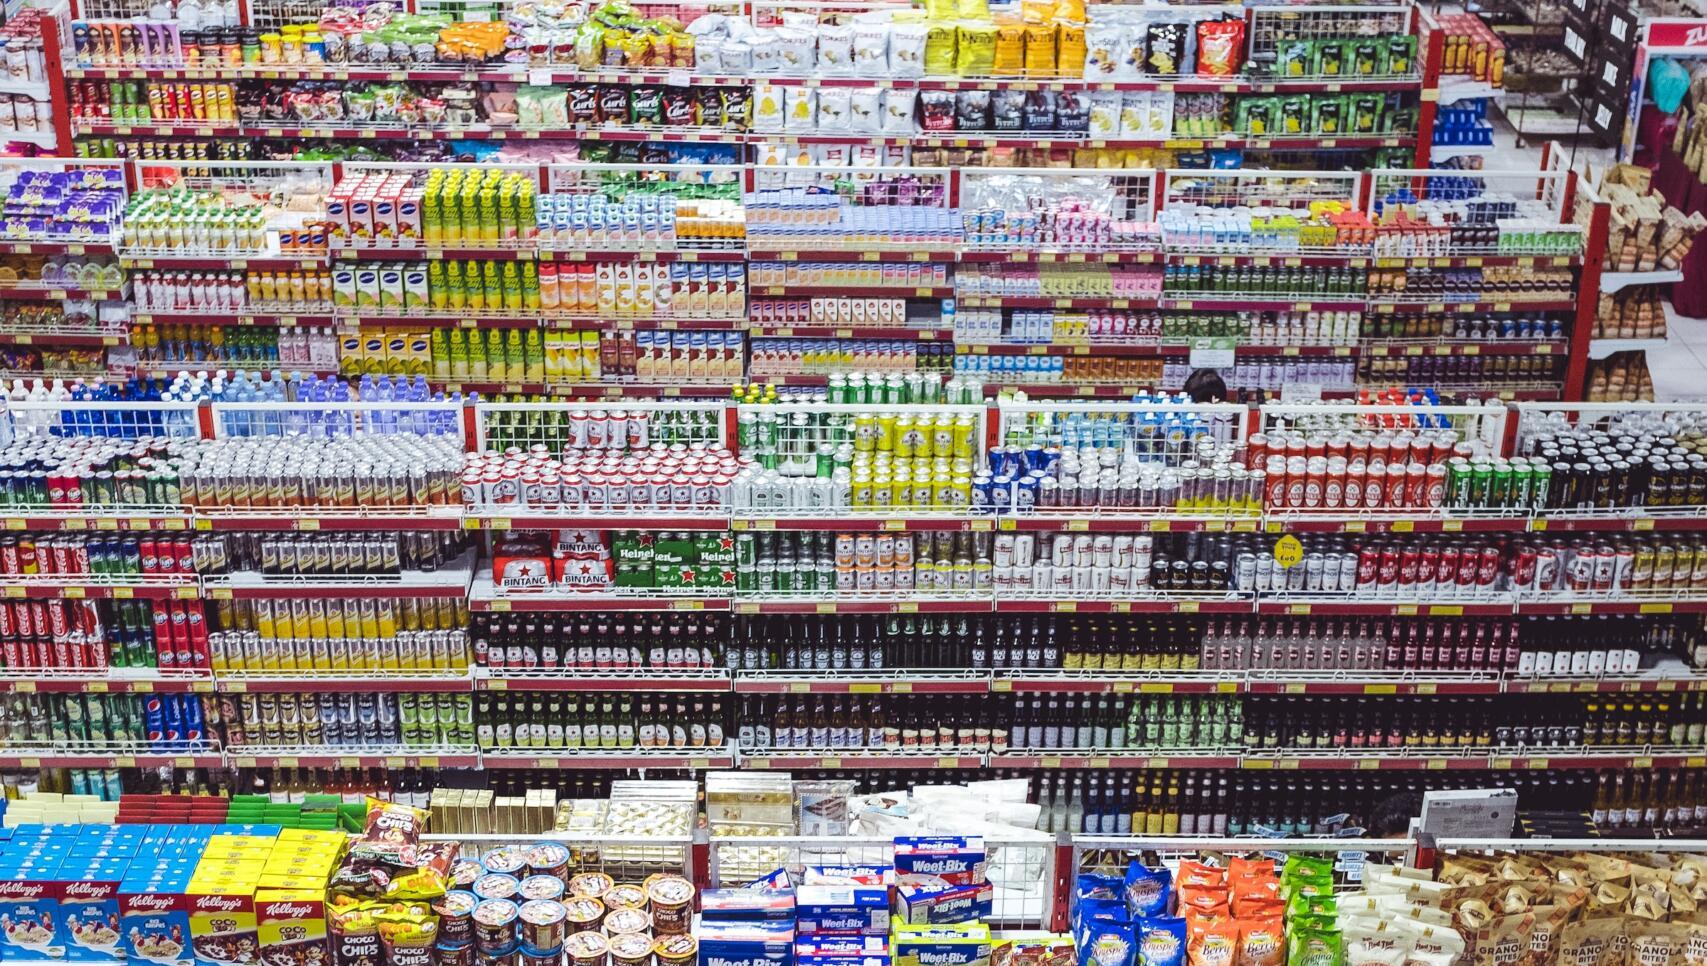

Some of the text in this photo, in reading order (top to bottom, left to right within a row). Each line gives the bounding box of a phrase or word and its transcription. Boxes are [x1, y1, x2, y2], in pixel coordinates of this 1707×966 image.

[504, 577, 546, 587] BINTANG
[565, 575, 607, 583] BINTANG
[382, 811, 413, 821] CHOCO
[377, 816, 414, 832] CHIPS
[823, 867, 877, 876] Weet-Bix
[912, 860, 968, 872] Weet-Bix
[0, 882, 43, 896] Kellogg's
[66, 882, 111, 897] Kellogg's
[129, 895, 175, 909] Kellogg's
[196, 896, 242, 910] Kellogg's
[266, 902, 313, 918] Kellogg's
[821, 919, 864, 928] Weet-Bix
[342, 944, 378, 956] CHIPS
[1203, 944, 1230, 957] Berry
[1248, 942, 1276, 953] Berry
[393, 953, 430, 966] CHIPS
[920, 953, 967, 963] Weet-Bix
[1579, 956, 1598, 964] BITE
[1642, 954, 1666, 963] BITES
